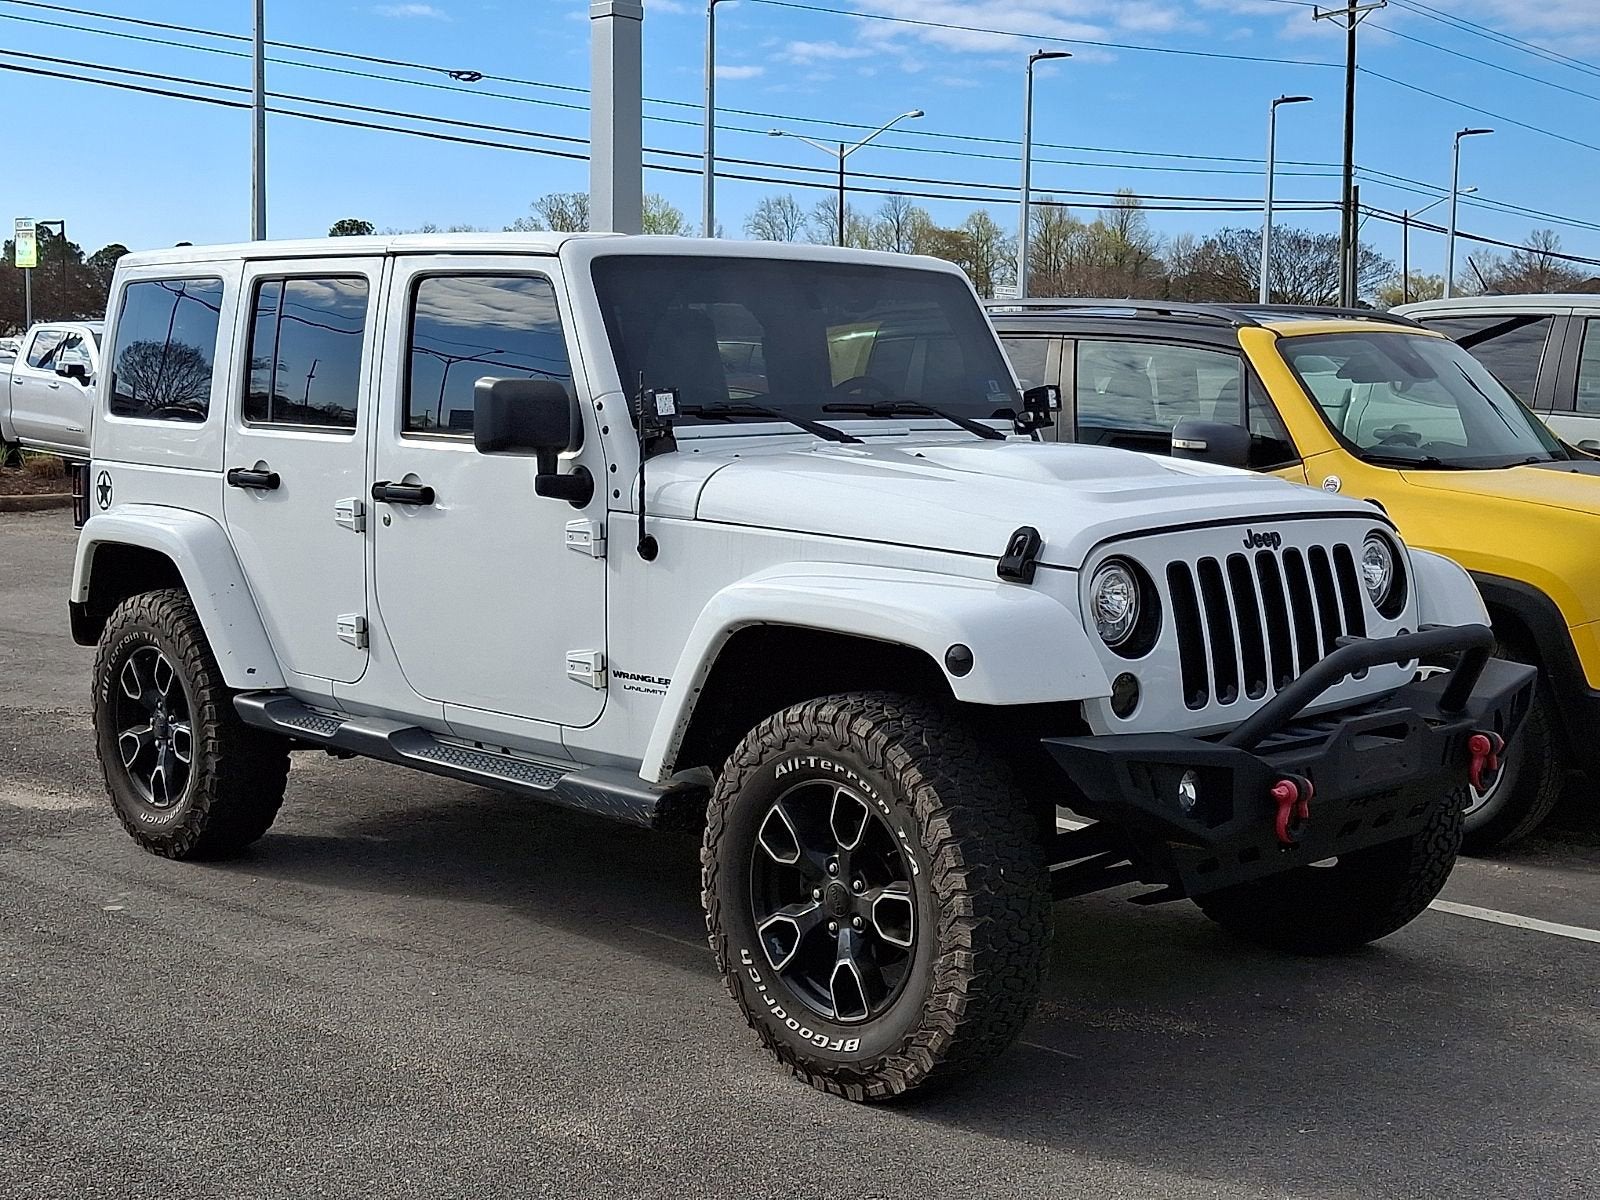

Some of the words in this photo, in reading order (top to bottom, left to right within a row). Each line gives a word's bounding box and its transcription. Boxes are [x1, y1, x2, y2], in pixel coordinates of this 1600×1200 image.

[1242, 528, 1282, 551] Jeep
[612, 669, 672, 686] WRANGLER
[623, 684, 668, 696] UNLIMIT
[774, 755, 891, 815] All-Terrain
[740, 948, 861, 1053] BFGoodrich
